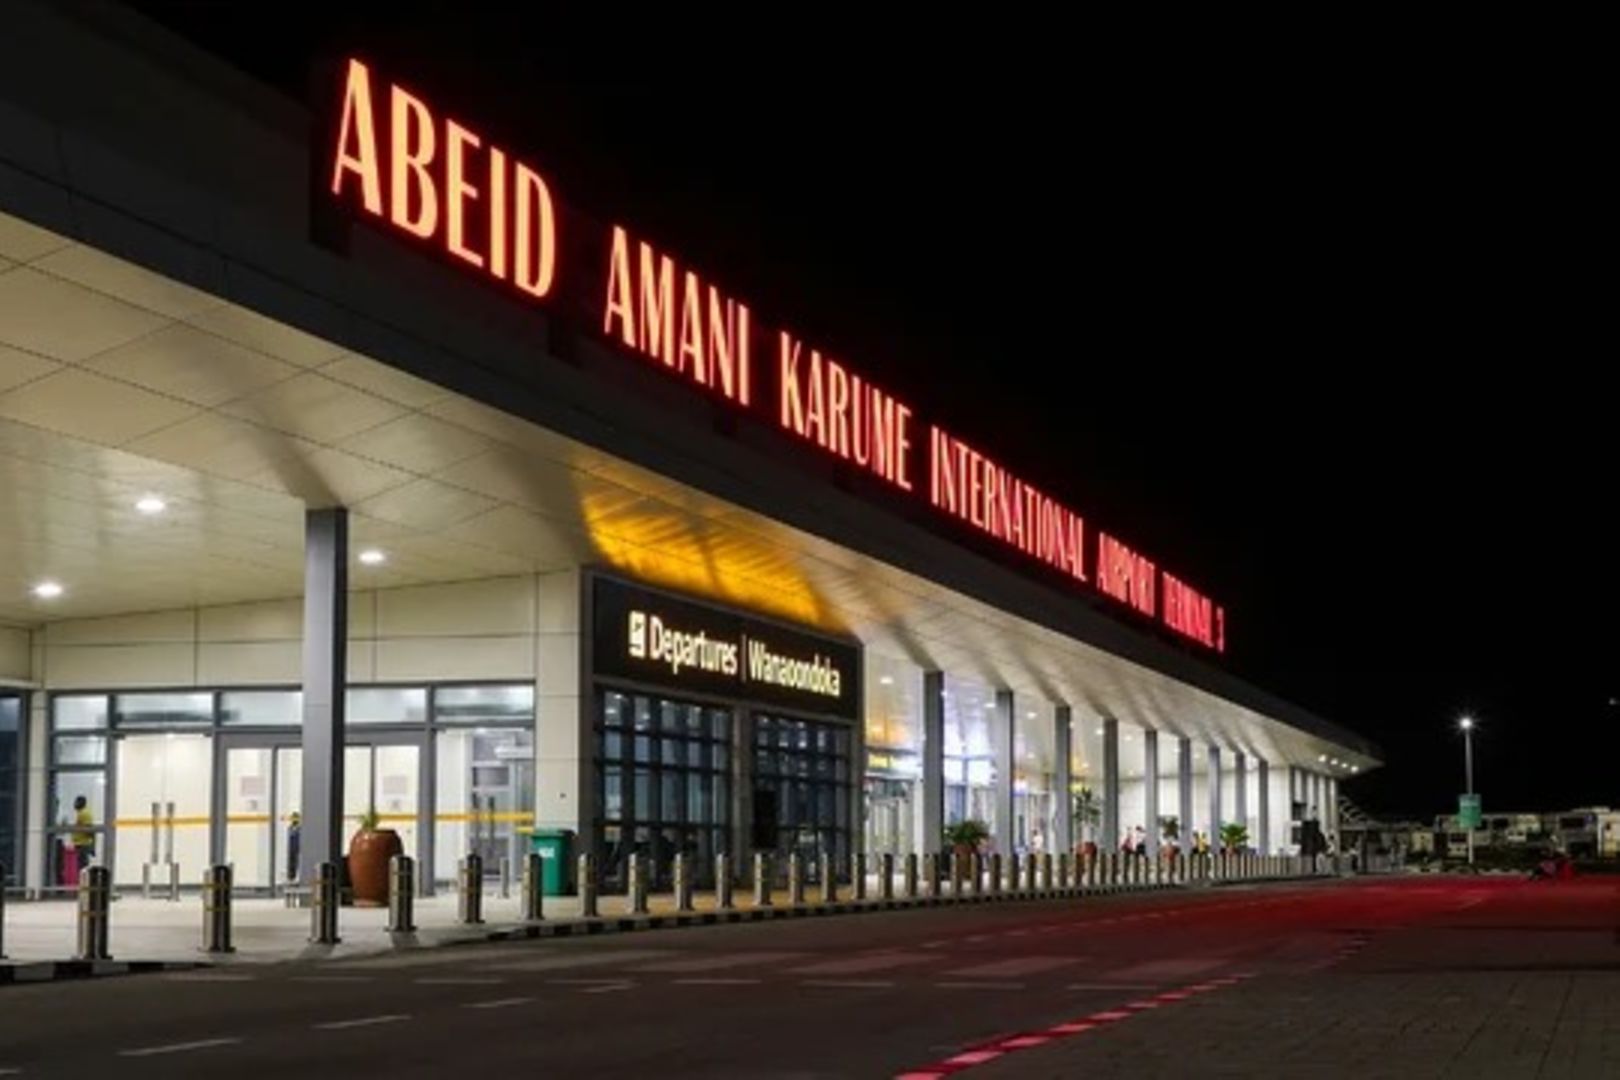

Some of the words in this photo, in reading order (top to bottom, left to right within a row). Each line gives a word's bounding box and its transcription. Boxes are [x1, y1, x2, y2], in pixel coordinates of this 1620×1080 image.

[332, 58, 556, 298] ABEID
[604, 226, 750, 407] AMANI
[780, 331, 912, 491] KARUME
[931, 426, 1088, 582] INTERNATIONAL
[649, 615, 738, 675] Departures
